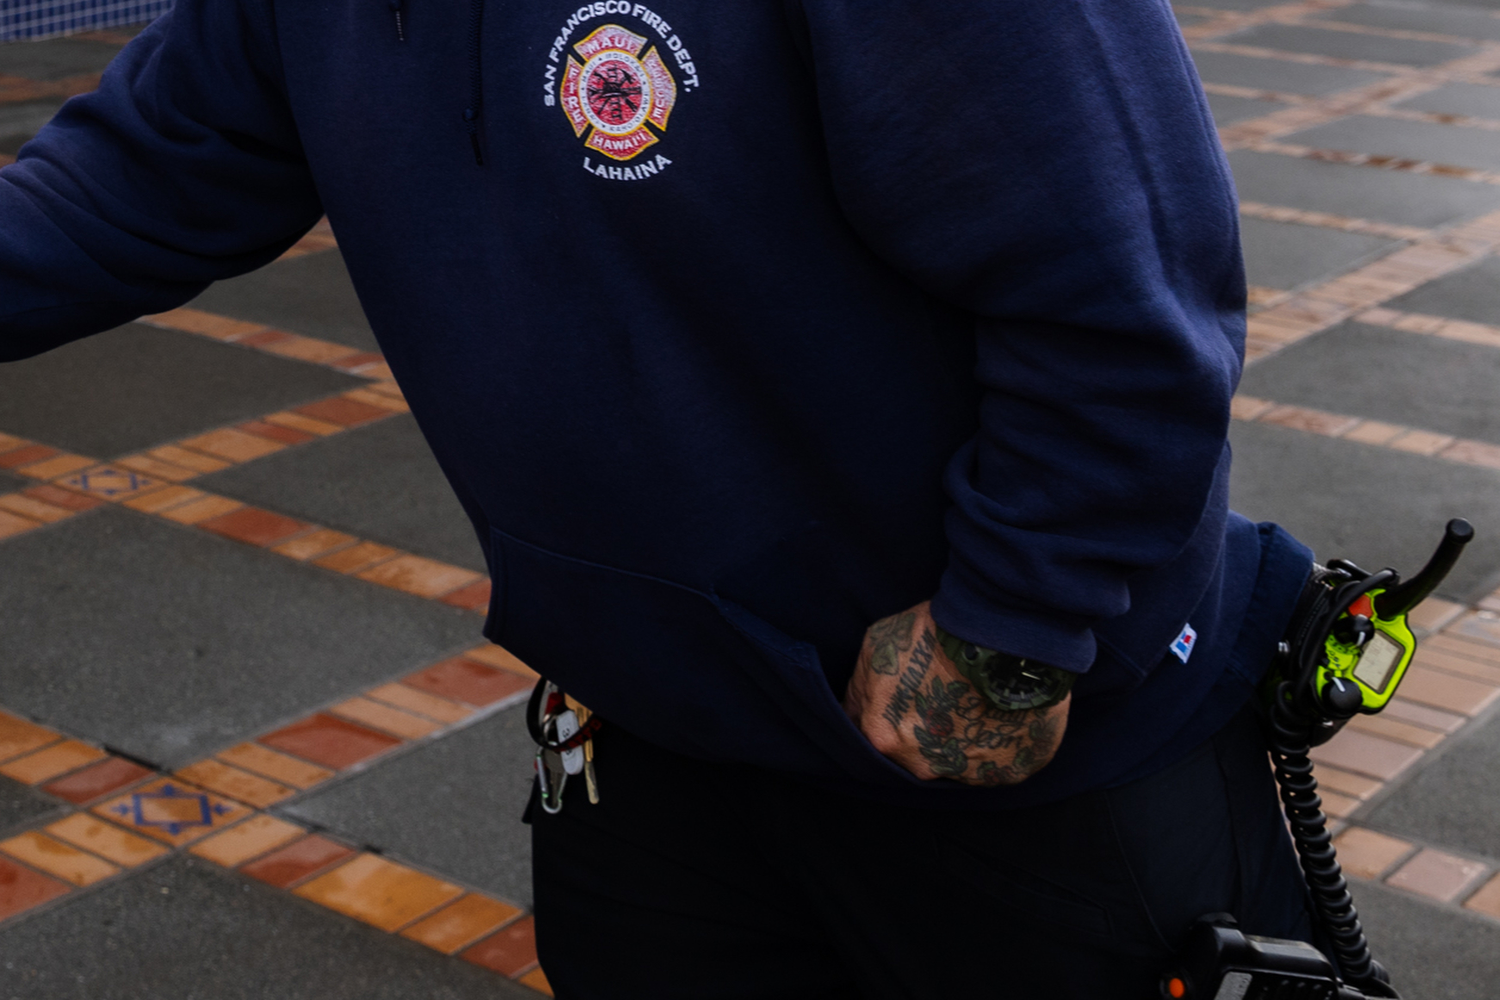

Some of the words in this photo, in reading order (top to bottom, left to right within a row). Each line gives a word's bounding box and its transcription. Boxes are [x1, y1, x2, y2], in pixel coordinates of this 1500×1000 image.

[550, 0, 631, 64] FRANCISCO
[631, 2, 672, 39] FIRE
[586, 36, 635, 55] MAUI
[665, 34, 700, 93] DEPT.
[543, 64, 558, 107] SAN
[568, 67, 587, 123] FIRE
[583, 154, 673, 181] LAHAINA
